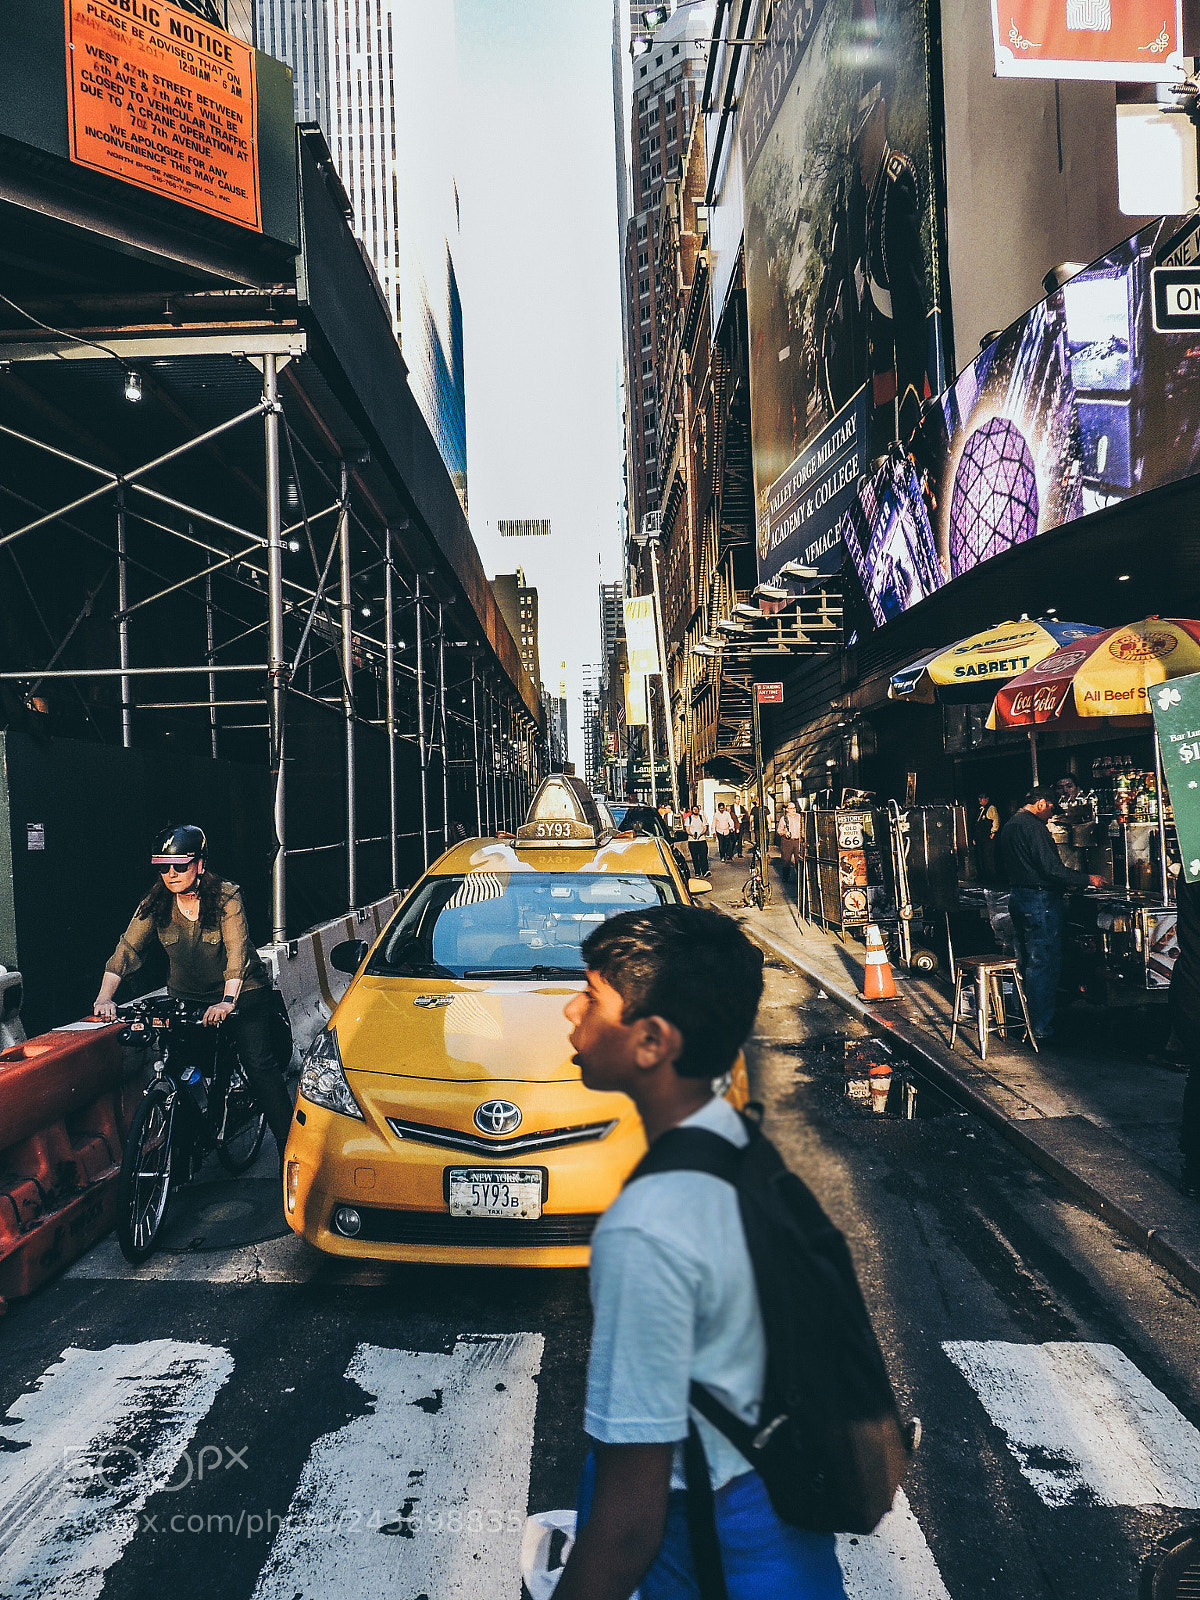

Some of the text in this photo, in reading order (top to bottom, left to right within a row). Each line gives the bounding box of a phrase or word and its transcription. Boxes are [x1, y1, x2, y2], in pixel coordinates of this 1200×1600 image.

[87, 4, 240, 85] PLEASE BE ADVISED THAT ON
[107, 0, 233, 63] BLIC NOTICE
[85, 43, 243, 124] WEST 47th STREET BETWEEN
[93, 62, 111, 77] 6th
[115, 71, 136, 88] AVE
[141, 82, 148, 93] &
[174, 97, 194, 112] AVE
[199, 107, 223, 126] WILL
[226, 120, 238, 133] BE
[179, 60, 210, 82] 12:01AM
[222, 80, 228, 89] 6
[231, 84, 242, 98] AM
[80, 82, 248, 162] DUE TO A CRANE OPERATION AT
[81, 70, 247, 150] CLOSED TO VEHICULAR TRAFFIC
[85, 125, 248, 199] INCONVENIENCE THIS MAY CAUSE.
[109, 123, 227, 179] WE APOLOGIZE FOR ANY
[151, 123, 168, 139] 7th
[172, 133, 213, 159] AVENUE.
[107, 150, 133, 164] NORTH
[135, 161, 161, 175] SHORE
[163, 171, 184, 184] NEON
[186, 180, 202, 191] SIGN
[1166, 239, 1191, 267] ONE
[770, 412, 857, 515] VALLEY FORGE MILITARY
[771, 453, 860, 550] ACADEMY & COLLEGE
[804, 516, 842, 564] VFMAC.E
[954, 656, 1030, 677] SABRETT
[1084, 687, 1148, 702] All Beef S
[1169, 733, 1185, 742] Bar
[537, 823, 571, 837] 5Y93
[844, 836, 859, 846] 66
[472, 1173, 520, 1183] NEW YORK
